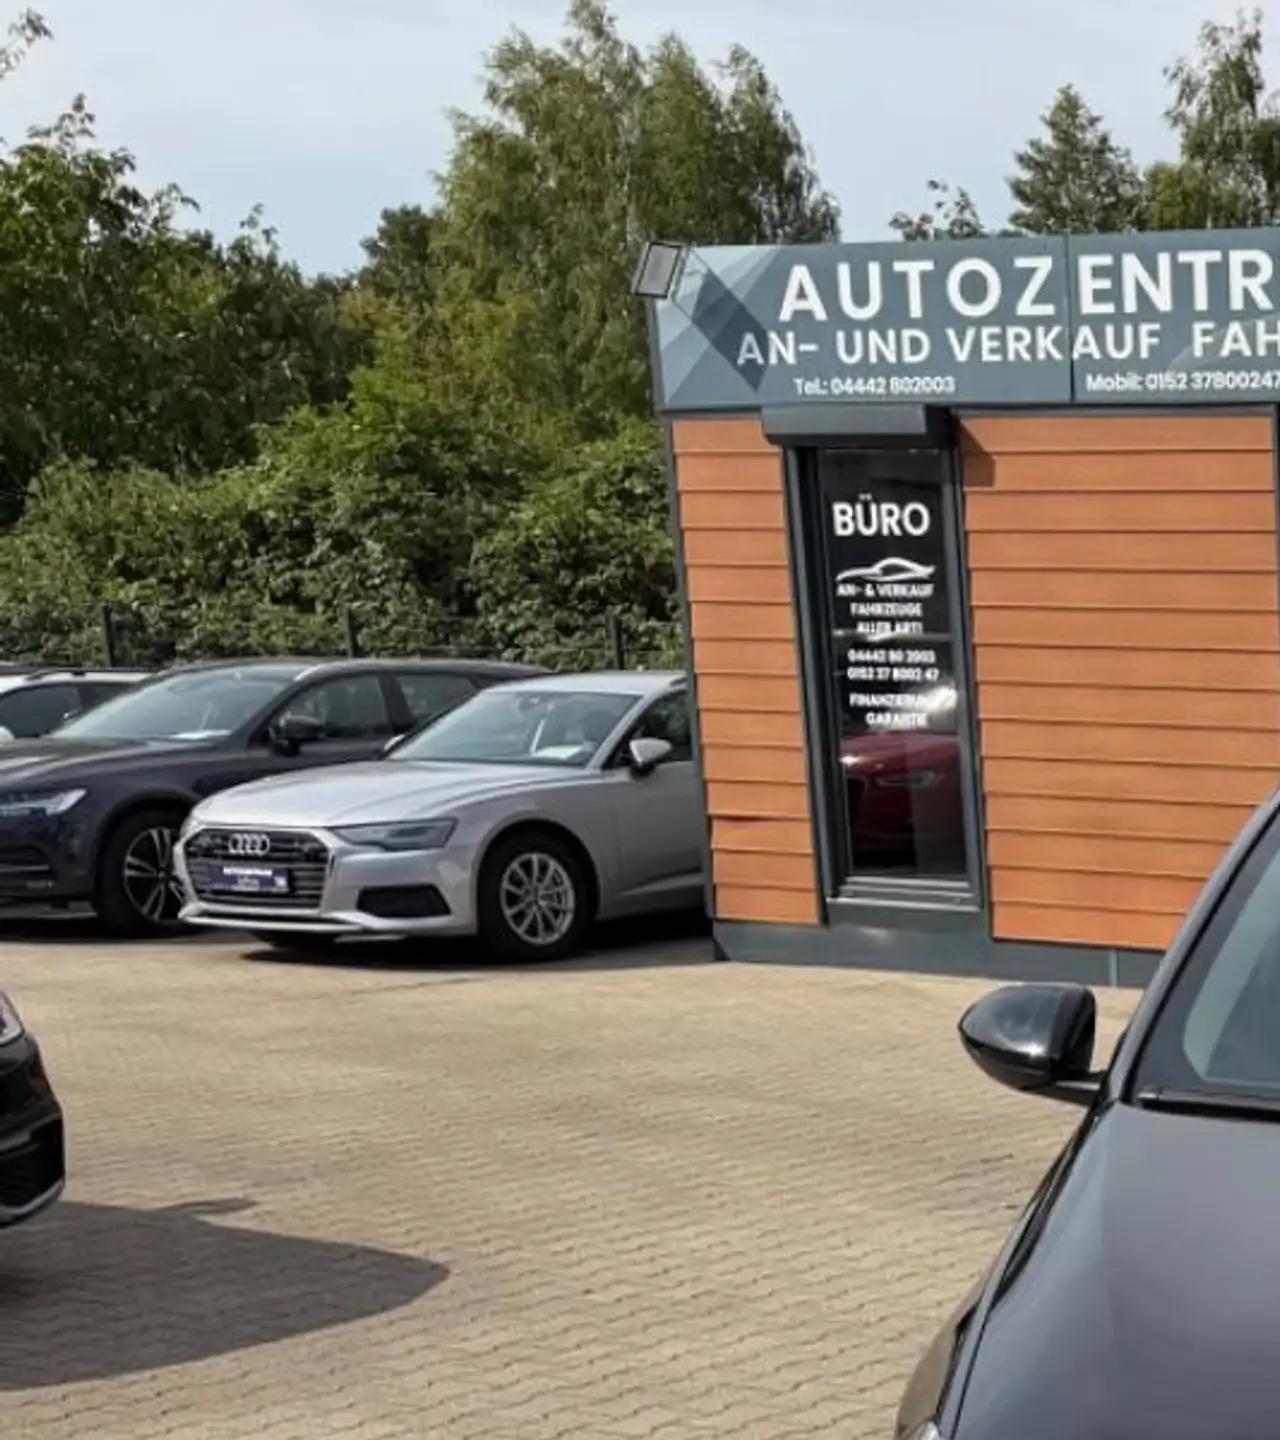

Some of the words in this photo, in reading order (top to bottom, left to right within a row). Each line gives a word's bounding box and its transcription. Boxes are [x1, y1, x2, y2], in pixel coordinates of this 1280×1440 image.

[738, 330, 819, 366] AN-
[838, 328, 929, 364] UND
[832, 492, 931, 537] BÜRO
